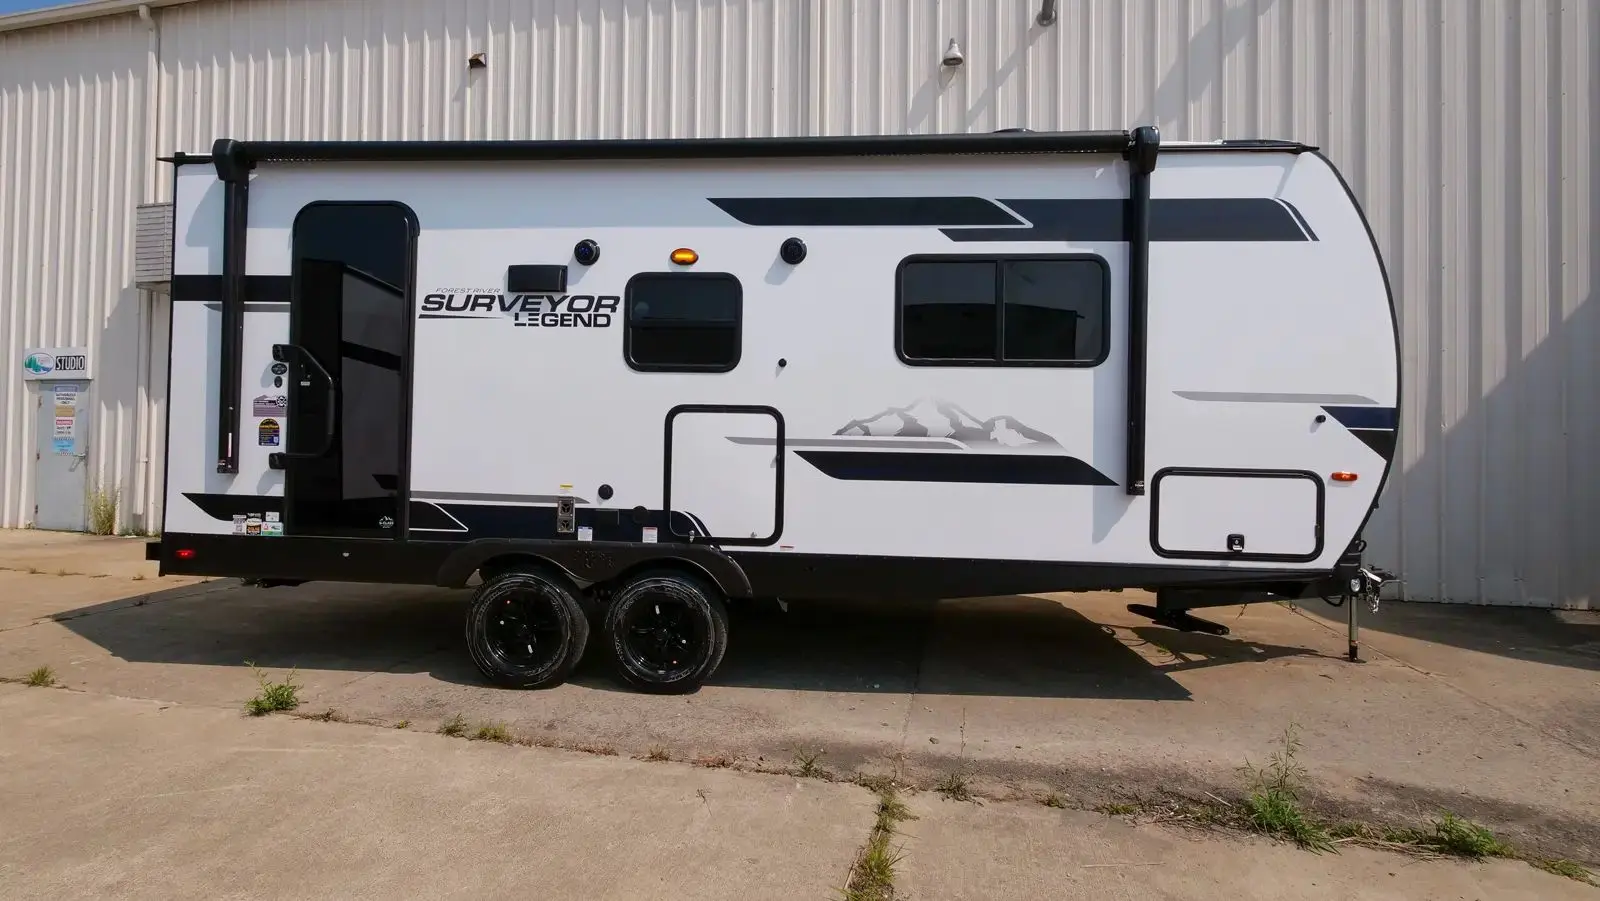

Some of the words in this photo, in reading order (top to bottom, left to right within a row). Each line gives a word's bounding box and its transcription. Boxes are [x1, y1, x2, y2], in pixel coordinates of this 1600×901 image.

[421, 294, 621, 313] SURVEYOR
[514, 312, 612, 328] LEGEND
[56, 356, 85, 369] STUDIO
